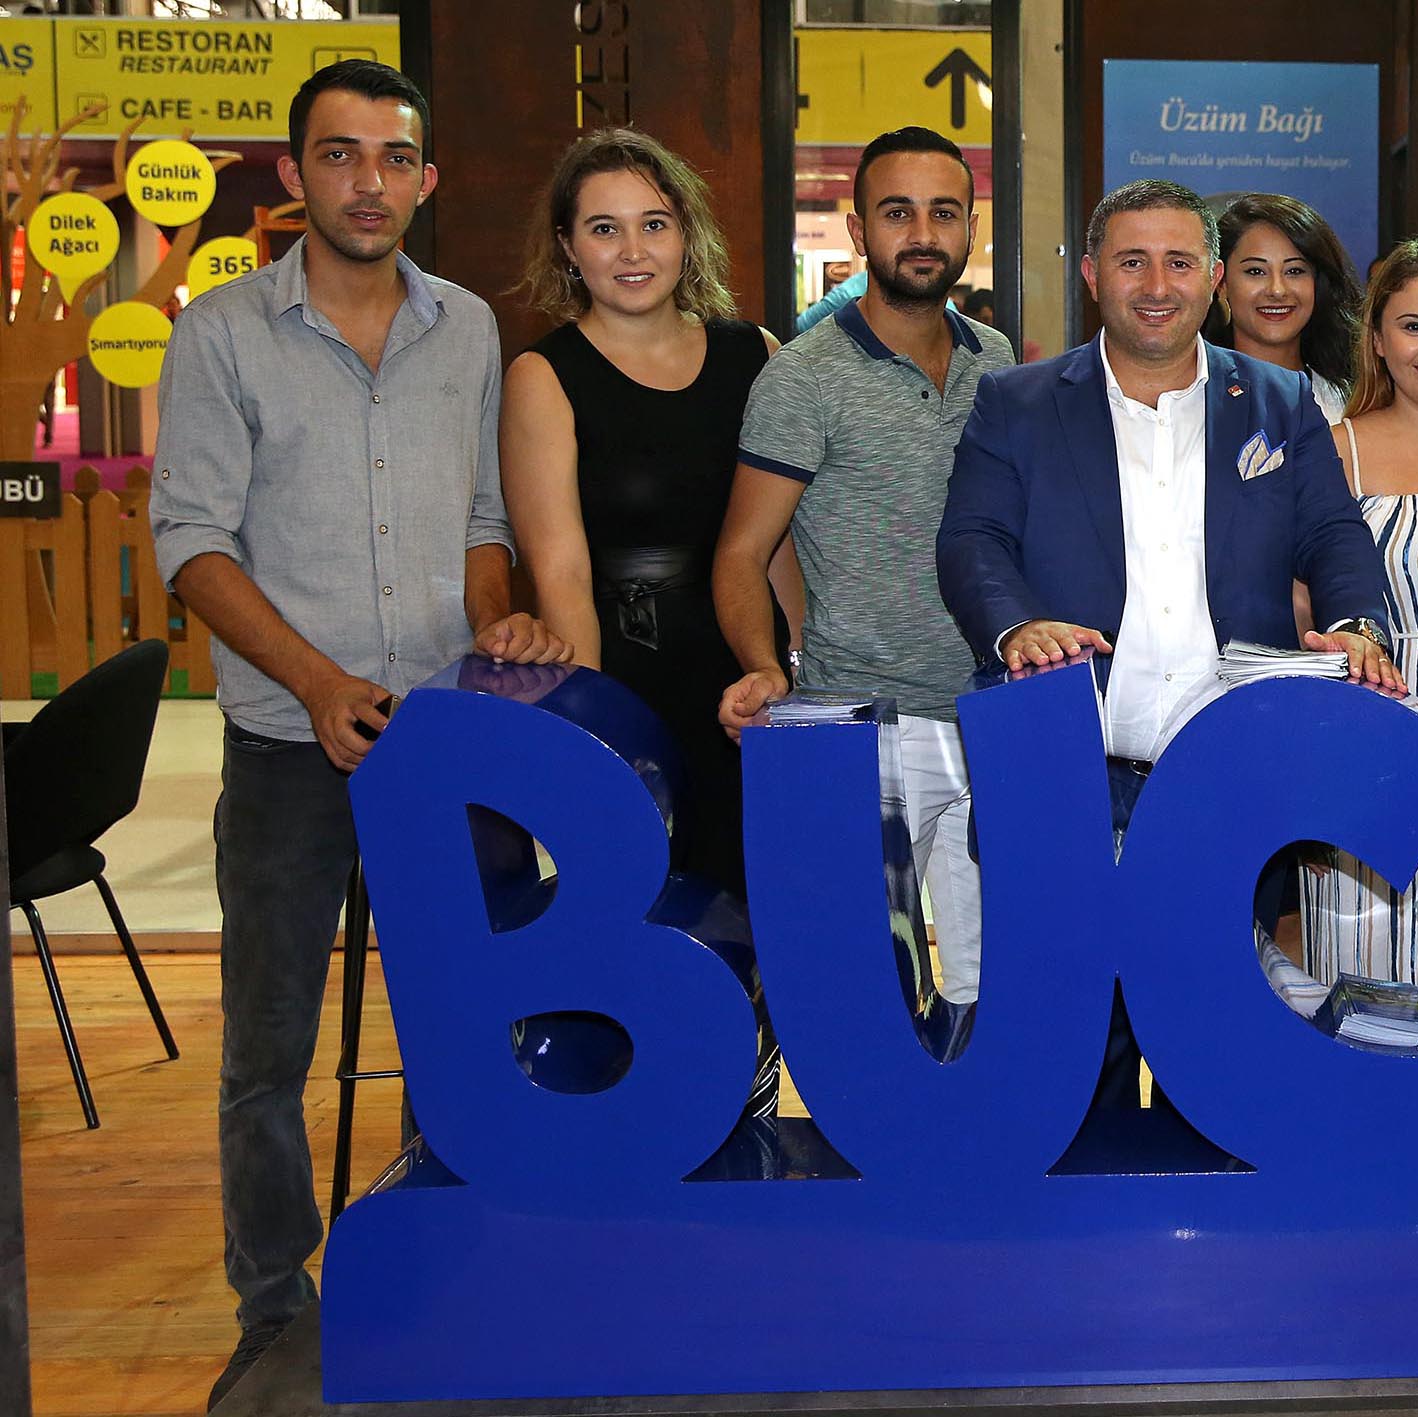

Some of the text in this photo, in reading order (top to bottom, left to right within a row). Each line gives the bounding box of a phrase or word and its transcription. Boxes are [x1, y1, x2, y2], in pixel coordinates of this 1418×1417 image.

[117, 30, 273, 52] RESTORAN
[119, 56, 273, 75] RESTAURANT
[121, 99, 193, 119] CAFE
[218, 101, 273, 120] BAR
[1160, 97, 1323, 142] Üzüm Bağı
[138, 164, 201, 180] Günlük
[142, 187, 199, 202] Bakım
[50, 216, 96, 230] Dilek
[50, 239, 99, 256] Ağacı
[209, 255, 254, 275] 365
[91, 338, 167, 352] Şımartıyoru
[0, 475, 44, 502] BÜ
